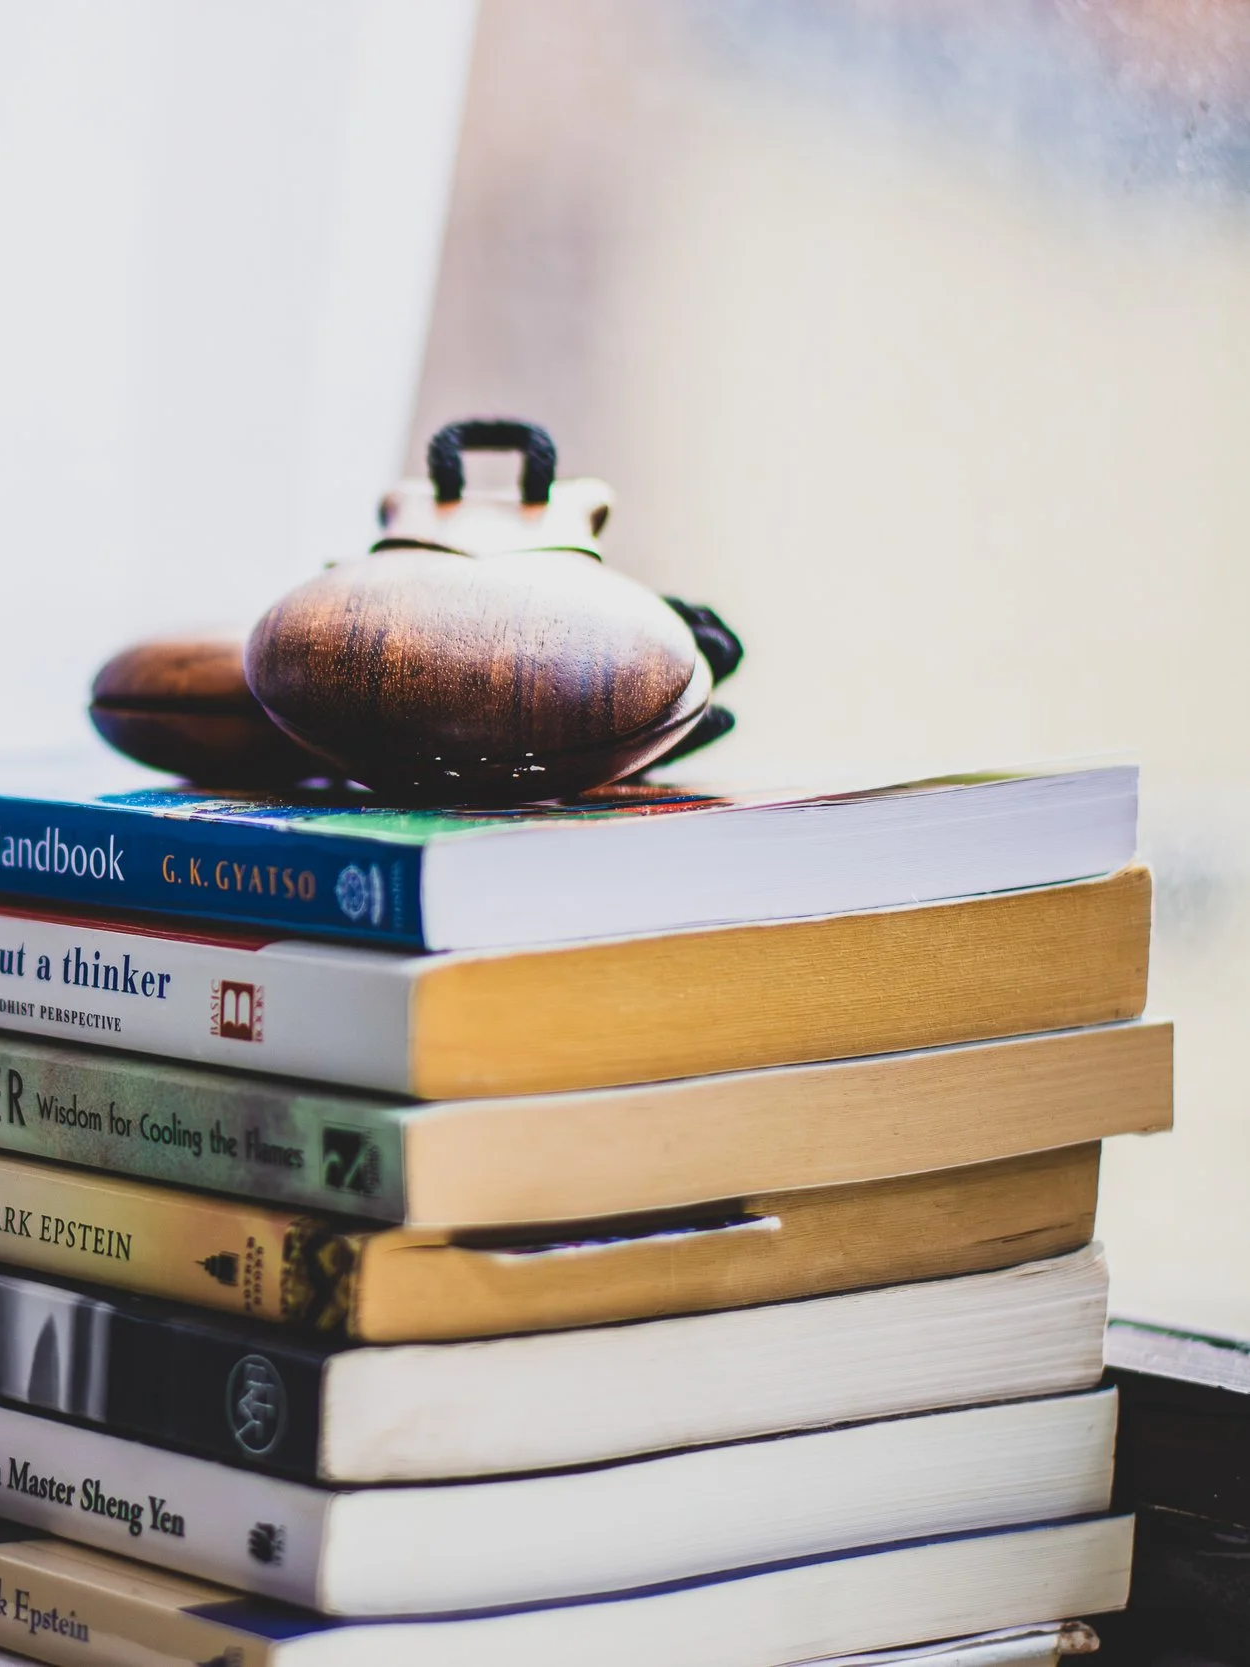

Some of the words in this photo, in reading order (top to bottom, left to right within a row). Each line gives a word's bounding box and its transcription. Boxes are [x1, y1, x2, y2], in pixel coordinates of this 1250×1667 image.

[36, 954, 52, 981] a
[63, 947, 171, 1000] thinker
[40, 1007, 122, 1032] PERSPECTIVE
[210, 979, 221, 1036] BASIC
[37, 1093, 101, 1132] Wisdom
[109, 1102, 132, 1137] for
[140, 1112, 202, 1157] Cooling
[210, 1120, 237, 1156] the
[40, 1216, 133, 1261] EPSTEIN
[8, 1458, 75, 1506] Master
[81, 1478, 144, 1537] Sheng
[149, 1496, 185, 1537] Yen
[14, 1588, 89, 1643] Epstein
